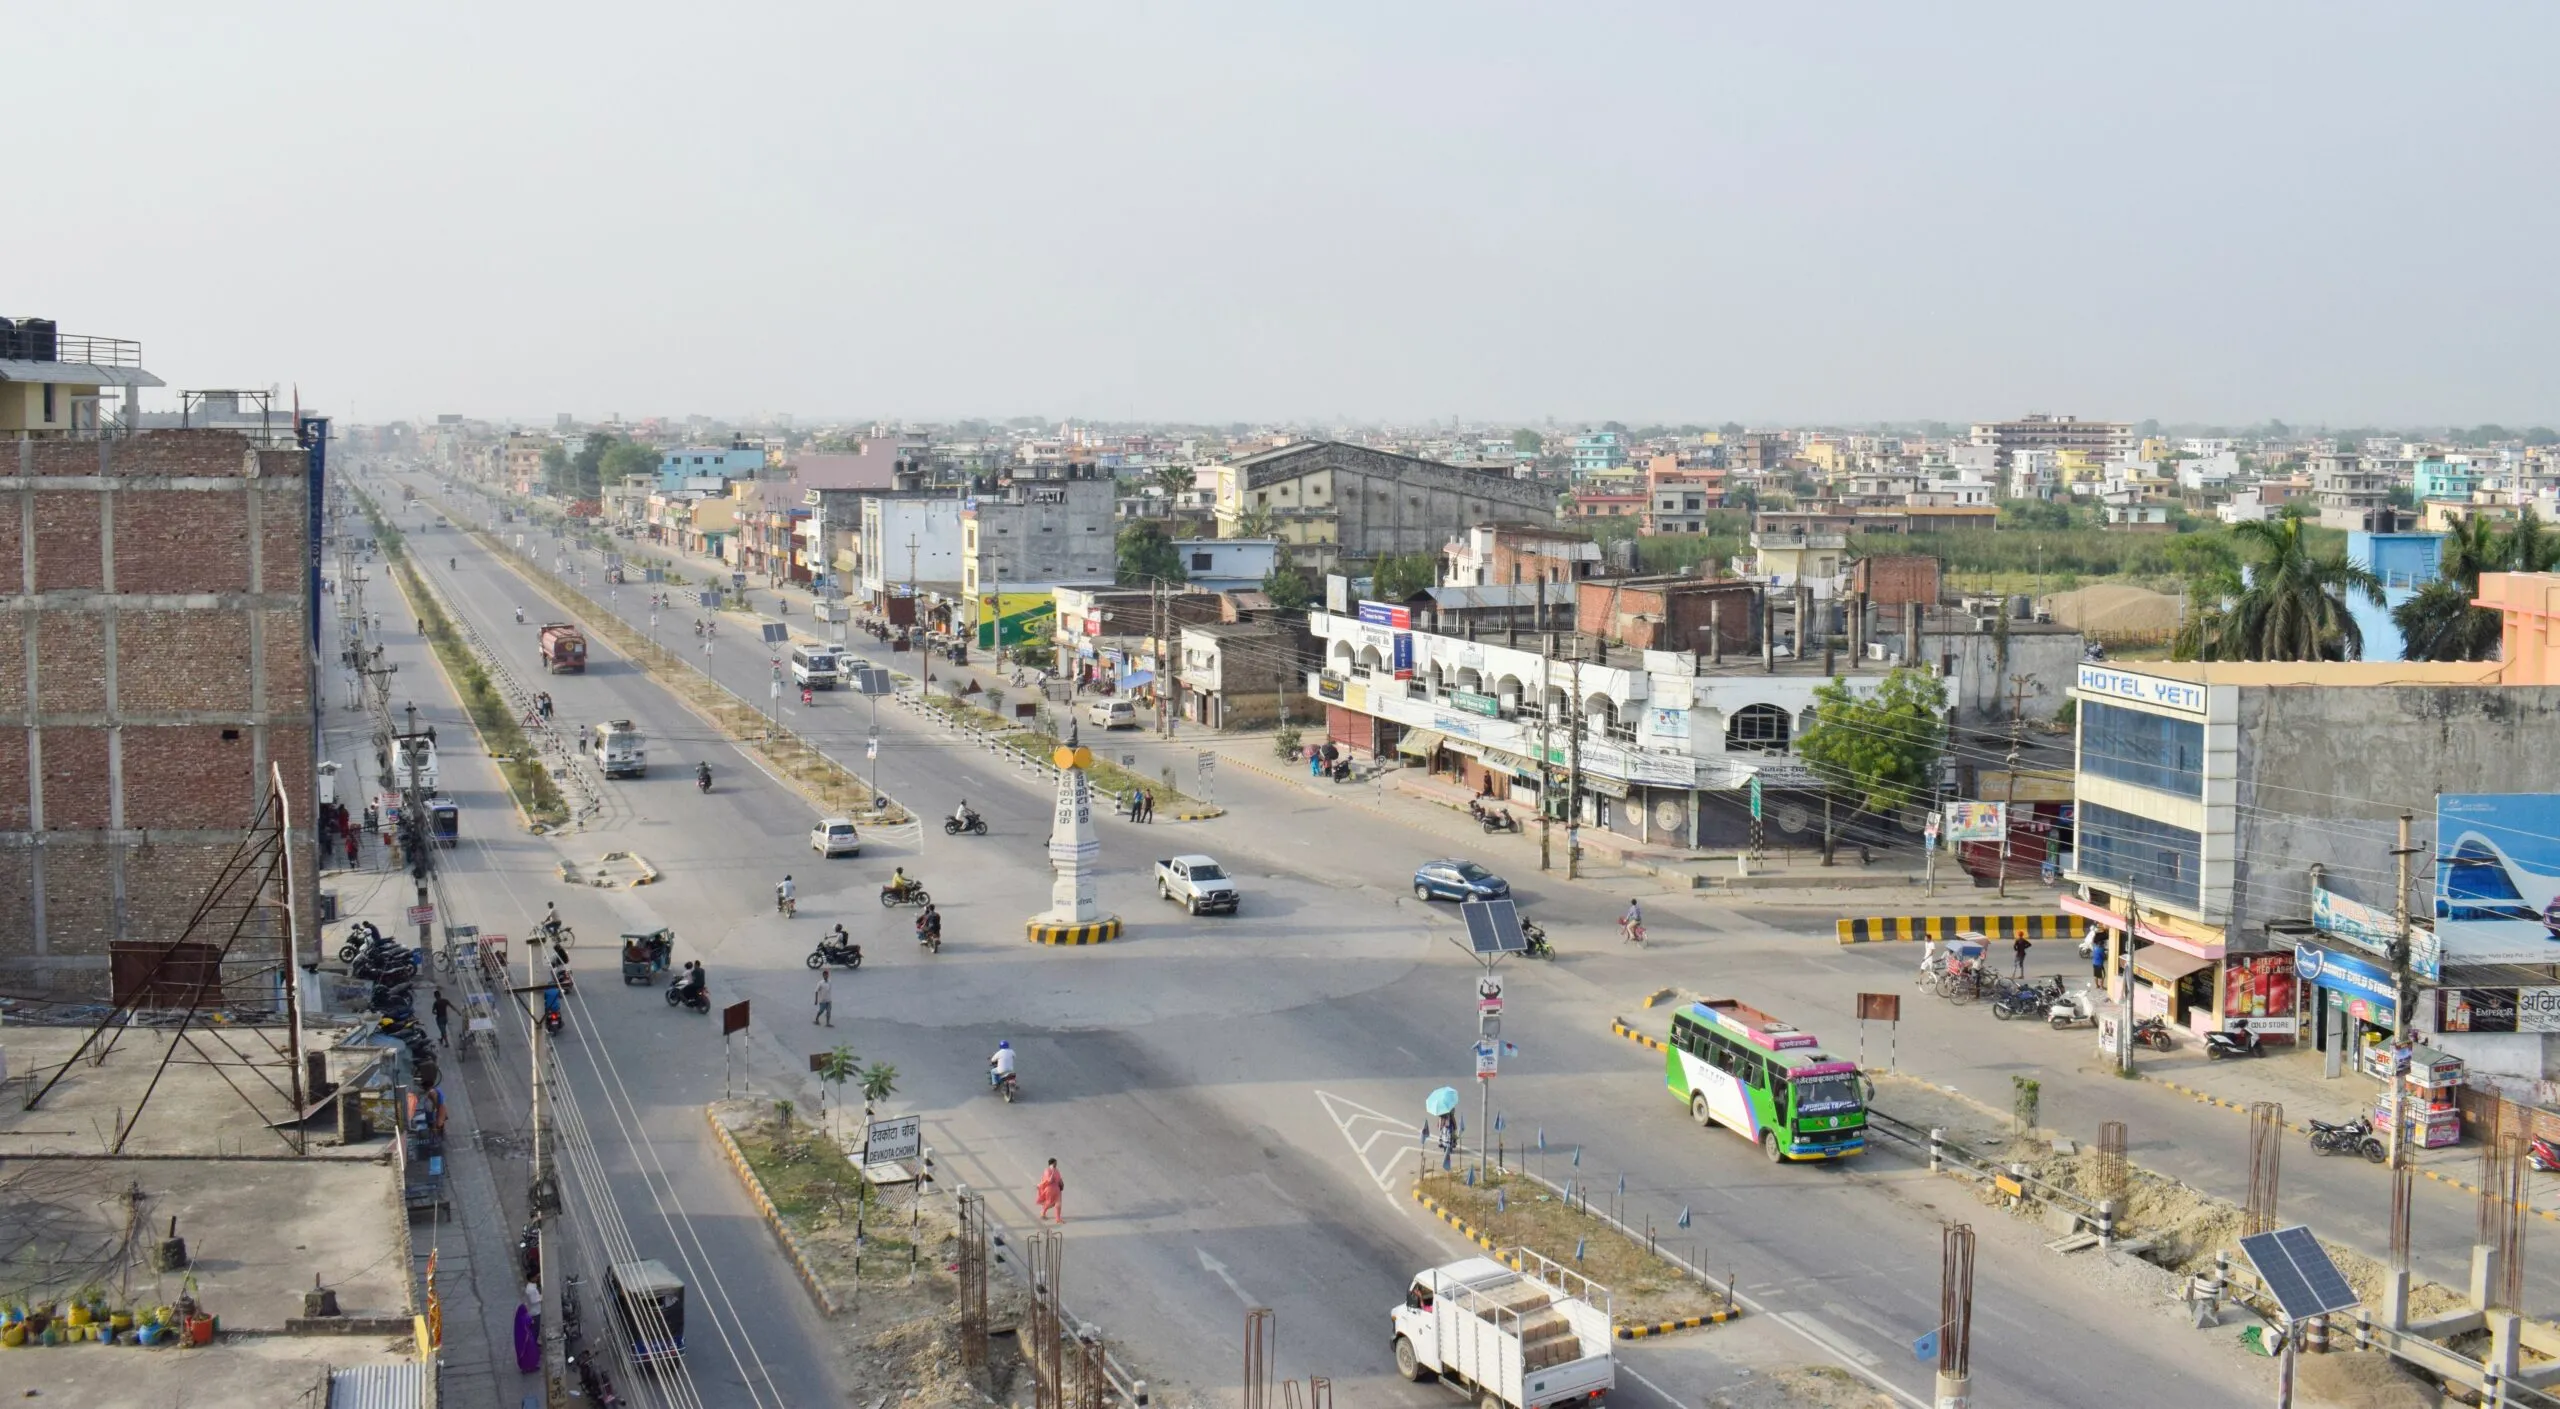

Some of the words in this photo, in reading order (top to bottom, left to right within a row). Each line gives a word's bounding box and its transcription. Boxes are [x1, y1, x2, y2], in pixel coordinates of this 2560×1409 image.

[2081, 670, 2145, 697] HOTEL
[2155, 683, 2200, 707] YETI
[2256, 965, 2270, 974] RED
[2347, 971, 2368, 988] COLD
[2475, 1007, 2514, 1017] EMPEROR
[2250, 1021, 2267, 1029] COLD
[2268, 1021, 2289, 1029] STORE
[872, 1124, 898, 1143] देवकोटा
[869, 1147, 895, 1162] DEVKOTA
[895, 1144, 916, 1156] CHOWK
